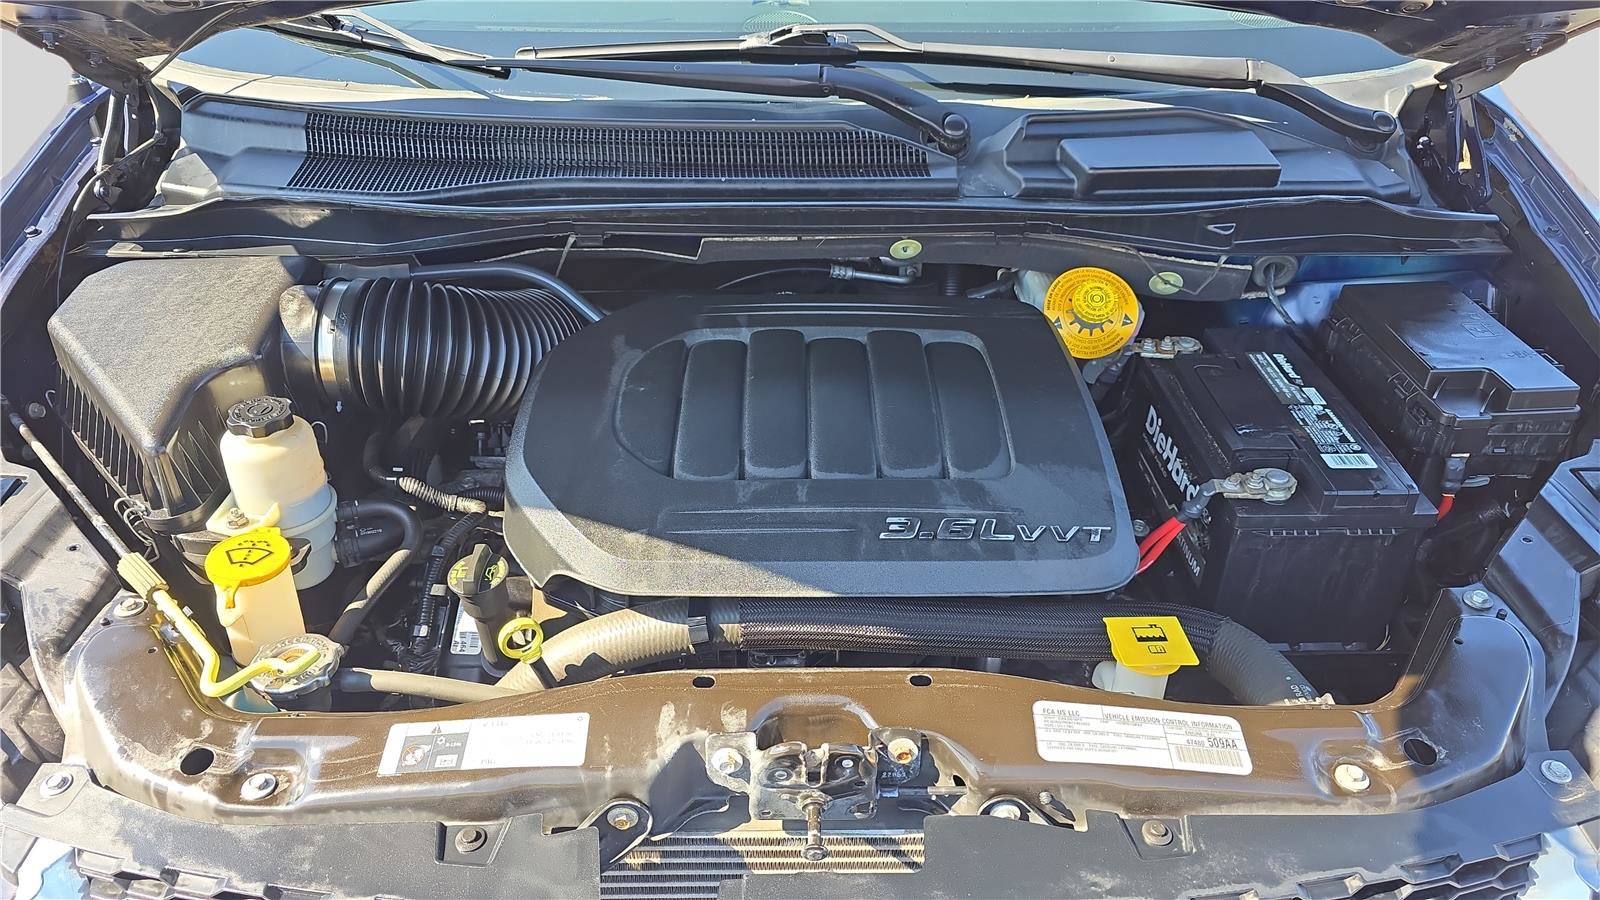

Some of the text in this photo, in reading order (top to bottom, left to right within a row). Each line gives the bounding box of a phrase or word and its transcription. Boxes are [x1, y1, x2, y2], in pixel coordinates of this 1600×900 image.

[1104, 713, 1129, 721] VEHICLE
[1131, 715, 1161, 724] EMISSION
[1162, 718, 1189, 727] CONTROL
[1191, 720, 1233, 730] INFORMATION
[1207, 737, 1238, 749] 509AA
